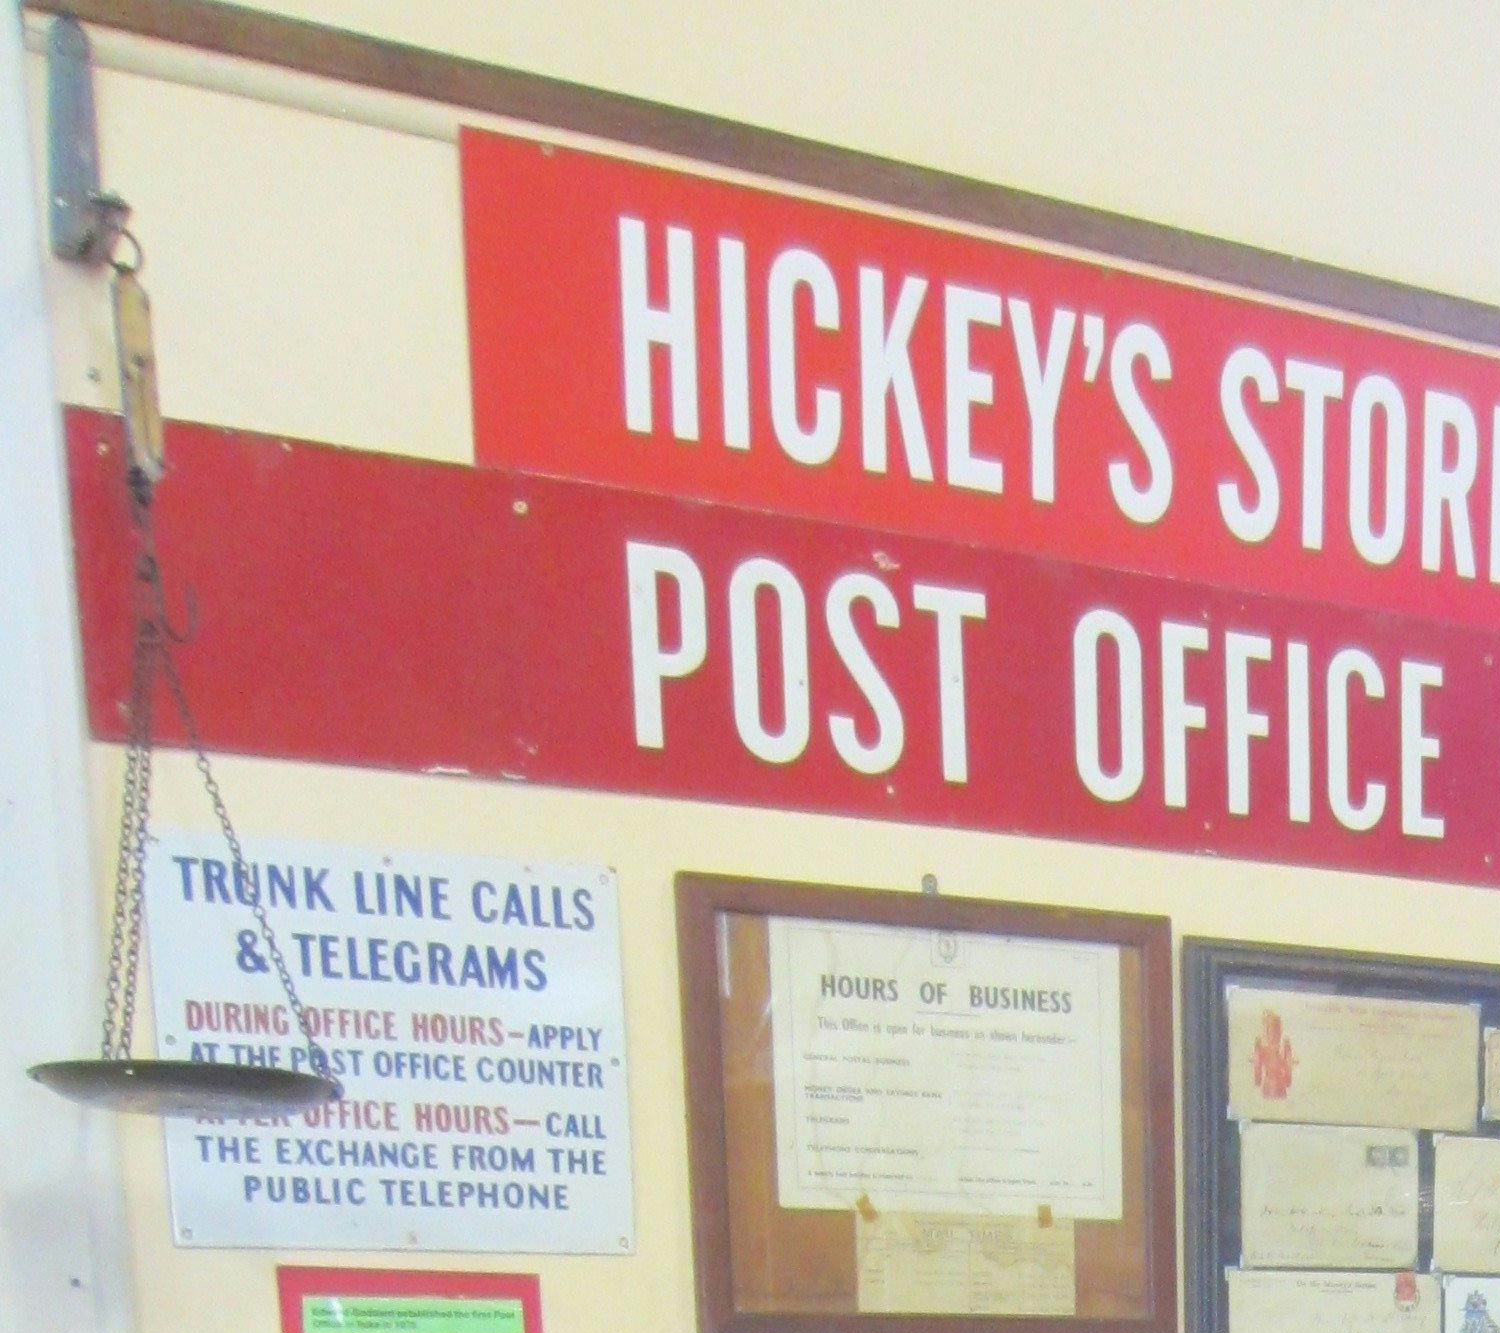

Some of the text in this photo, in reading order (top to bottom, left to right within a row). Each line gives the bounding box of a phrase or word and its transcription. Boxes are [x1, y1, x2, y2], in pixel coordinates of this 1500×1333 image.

[617, 215, 1175, 525] HICKEY'S
[625, 540, 986, 784] POST
[1072, 608, 1445, 839] OFFICE
[171, 855, 596, 932] TRUNK LINE CALLS
[236, 929, 549, 992] & TELEGRAMS
[820, 974, 1072, 1014] HOURS OF BUSINESS
[185, 1000, 289, 1037] DURING
[303, 1006, 397, 1042] OFFICE
[229, 1043, 281, 1069] THE
[375, 1051, 467, 1082] OFFICE
[476, 1056, 603, 1089] COUNTER
[303, 1101, 398, 1133] OFFICE
[194, 1134, 607, 1175] THE EXCHANGE FROM THE
[244, 1176, 570, 1211] PUBLIC TELEPHONE
